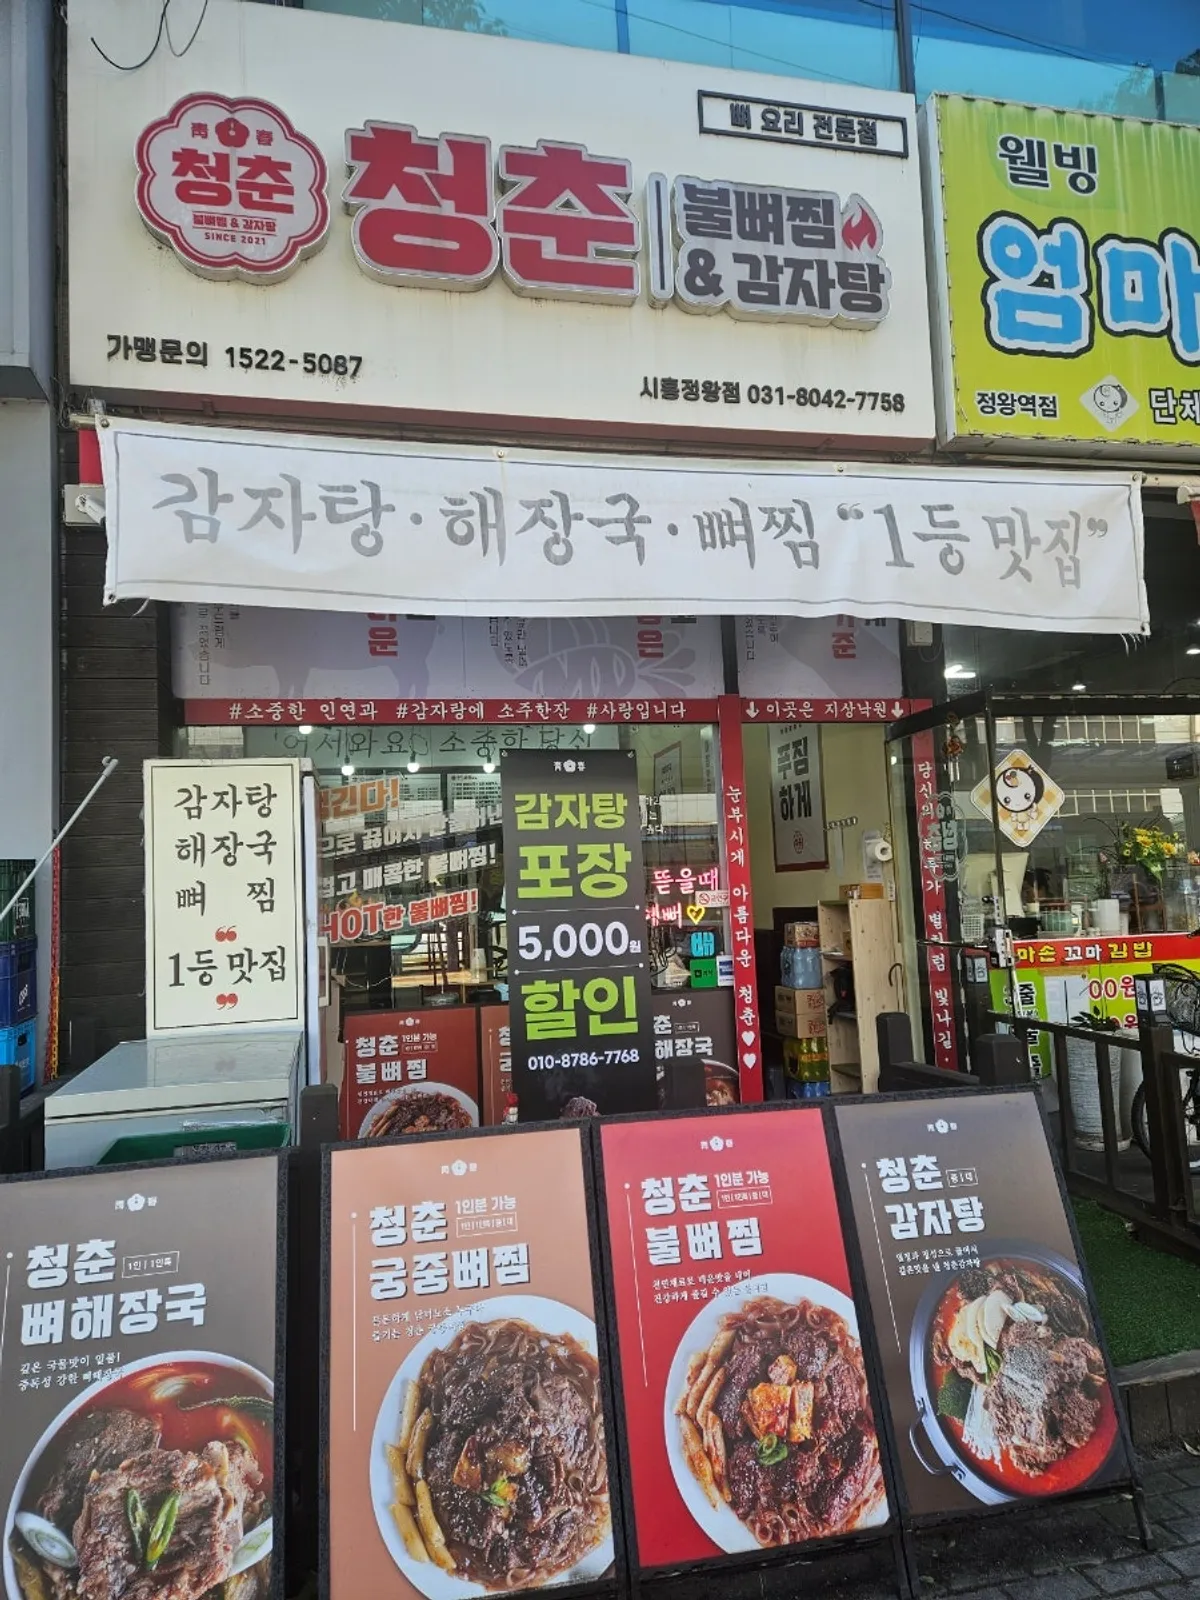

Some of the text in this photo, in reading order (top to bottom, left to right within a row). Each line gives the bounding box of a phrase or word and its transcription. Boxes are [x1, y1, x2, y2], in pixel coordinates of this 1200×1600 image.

[761, 107, 804, 136] 요리
[813, 113, 878, 146] 전문점
[172, 147, 294, 214] 청춘
[998, 133, 1098, 195] 웰빙
[349, 125, 639, 292] 청춘
[682, 182, 836, 249] 불뼈찜
[204, 232, 266, 245] SINCE 2021
[685, 248, 886, 312] & 감자탕
[107, 334, 362, 378] 가맹문의 1522-5087
[640, 375, 905, 413] 시흥정왕점 031-8042-7758
[976, 391, 1059, 419] 정왕역점
[153, 467, 396, 558] 감자탕
[439, 486, 652, 567] 해장국
[692, 498, 820, 570] 뼈찜
[229, 701, 306, 721] #소중한
[320, 702, 378, 721] 인연과
[498, 702, 570, 721] 소주한잔
[586, 702, 687, 720] #사랑입니다
[766, 701, 888, 719] 이곳은 지상낙원
[174, 783, 277, 820] 감자탕
[514, 793, 628, 830] 감자탕
[175, 830, 277, 868] 해장국
[517, 842, 632, 898] 포장
[651, 867, 718, 894] 뜯을때
[726, 786, 756, 1027] 눈부시게 아름다운 청춘
[168, 945, 286, 987] 1등 맛집
[1064, 944, 1102, 962] 꼬마
[1108, 941, 1153, 959] 김밥
[521, 975, 639, 1041] 할인
[355, 1034, 399, 1059] 청춘
[527, 1048, 640, 1071] 010-8786-7768
[654, 1035, 713, 1060] 해장국
[355, 1058, 427, 1085] 불뼈찜
[714, 1170, 770, 1188] 1인분 가능
[877, 1154, 944, 1194] 청춘
[491, 1195, 517, 1210] 가능
[641, 1173, 712, 1216] 청춘
[370, 1201, 448, 1248] 청춘
[884, 1196, 986, 1241] 감자탕
[646, 1217, 763, 1266] 불뼈찜
[26, 1239, 117, 1290] 청춘
[370, 1243, 530, 1301] 궁중뼈찜
[20, 1283, 207, 1346] 뼈해장국
[46, 1355, 90, 1371] 국물맛이
